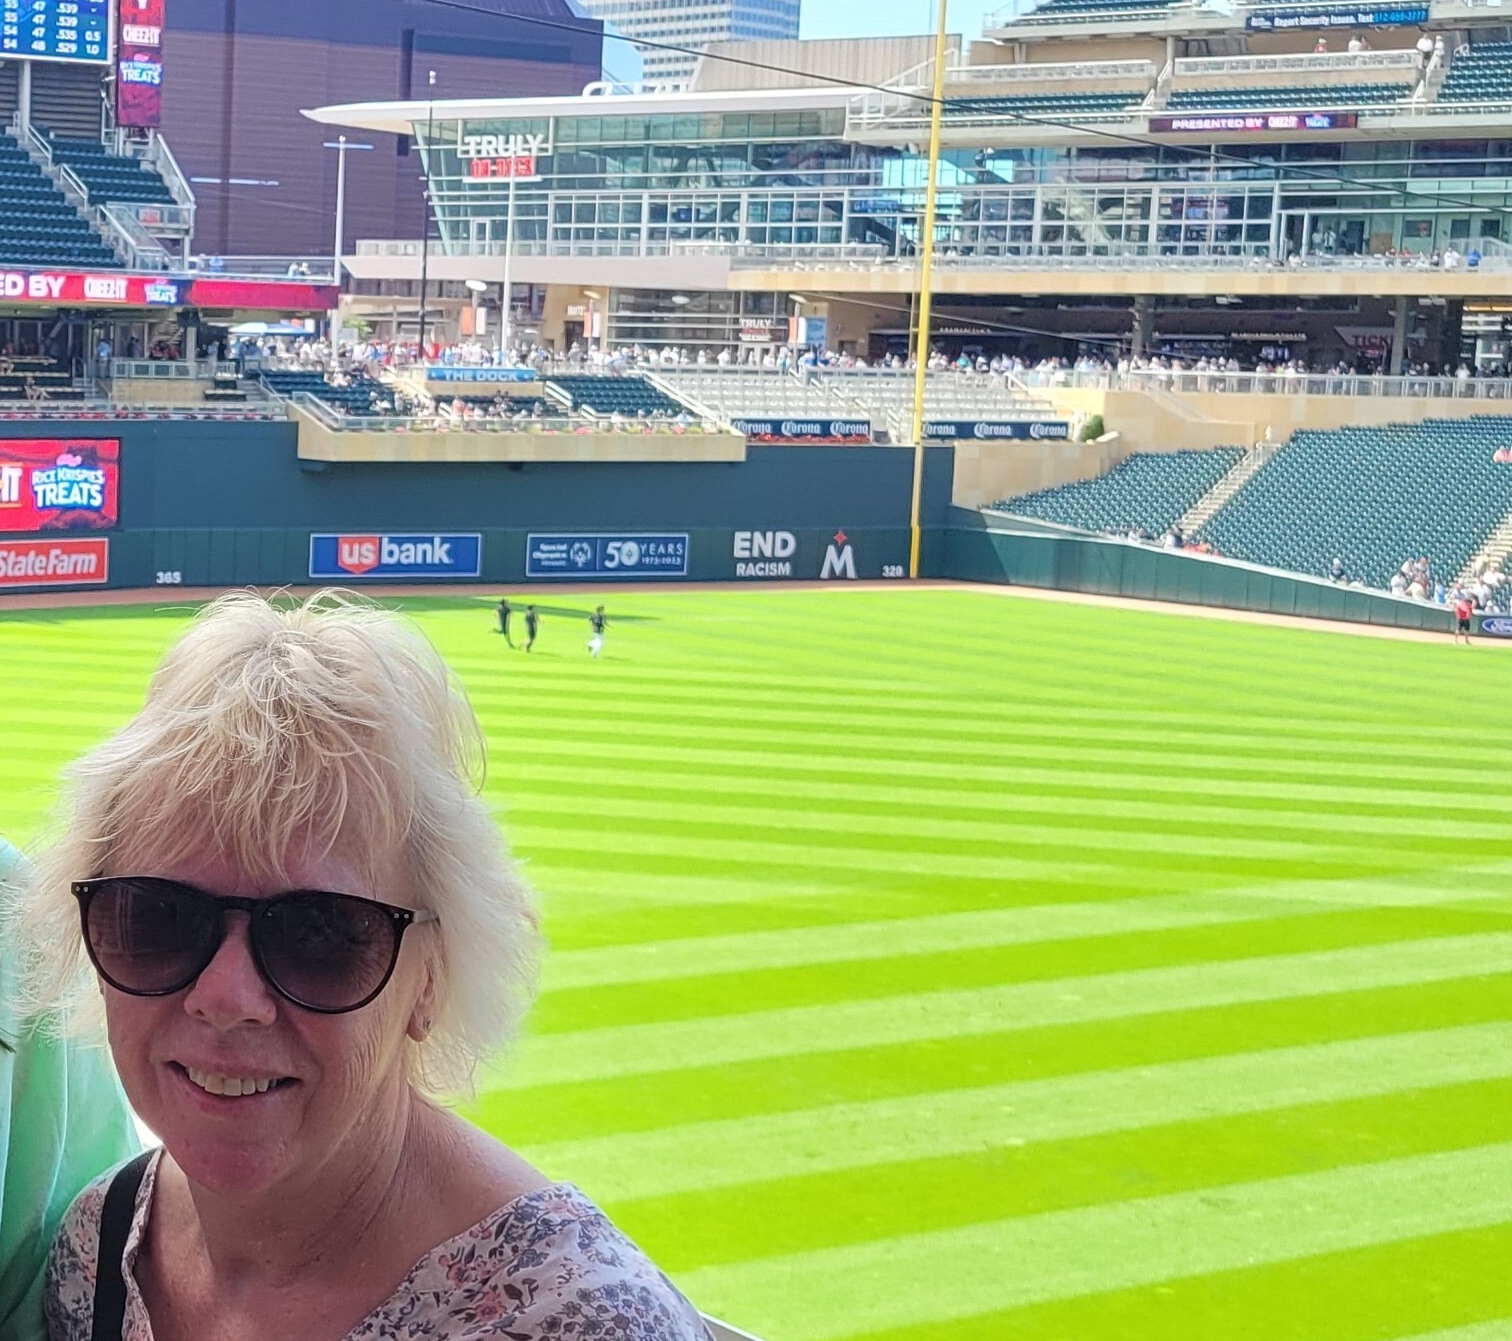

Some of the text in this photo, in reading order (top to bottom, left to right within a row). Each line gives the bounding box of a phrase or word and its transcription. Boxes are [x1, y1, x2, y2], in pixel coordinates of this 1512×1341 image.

[1171, 117, 1245, 130] PRESENTED
[1245, 116, 1264, 128] BY
[464, 133, 544, 157] TRULY
[29, 274, 66, 298] BY
[1352, 334, 1390, 347] TICK
[445, 369, 519, 382] THE DOCK
[781, 421, 821, 436] Corona
[830, 422, 869, 436] Corona
[974, 423, 1012, 437] Corona
[1029, 423, 1069, 438] Corona
[32, 469, 56, 486] RICE
[34, 482, 103, 508] TREATS
[381, 537, 451, 564] bank
[641, 543, 683, 555] YEARS
[733, 532, 797, 558] END
[604, 541, 641, 569] 50
[736, 562, 791, 577] RACISM
[156, 571, 182, 584] 365
